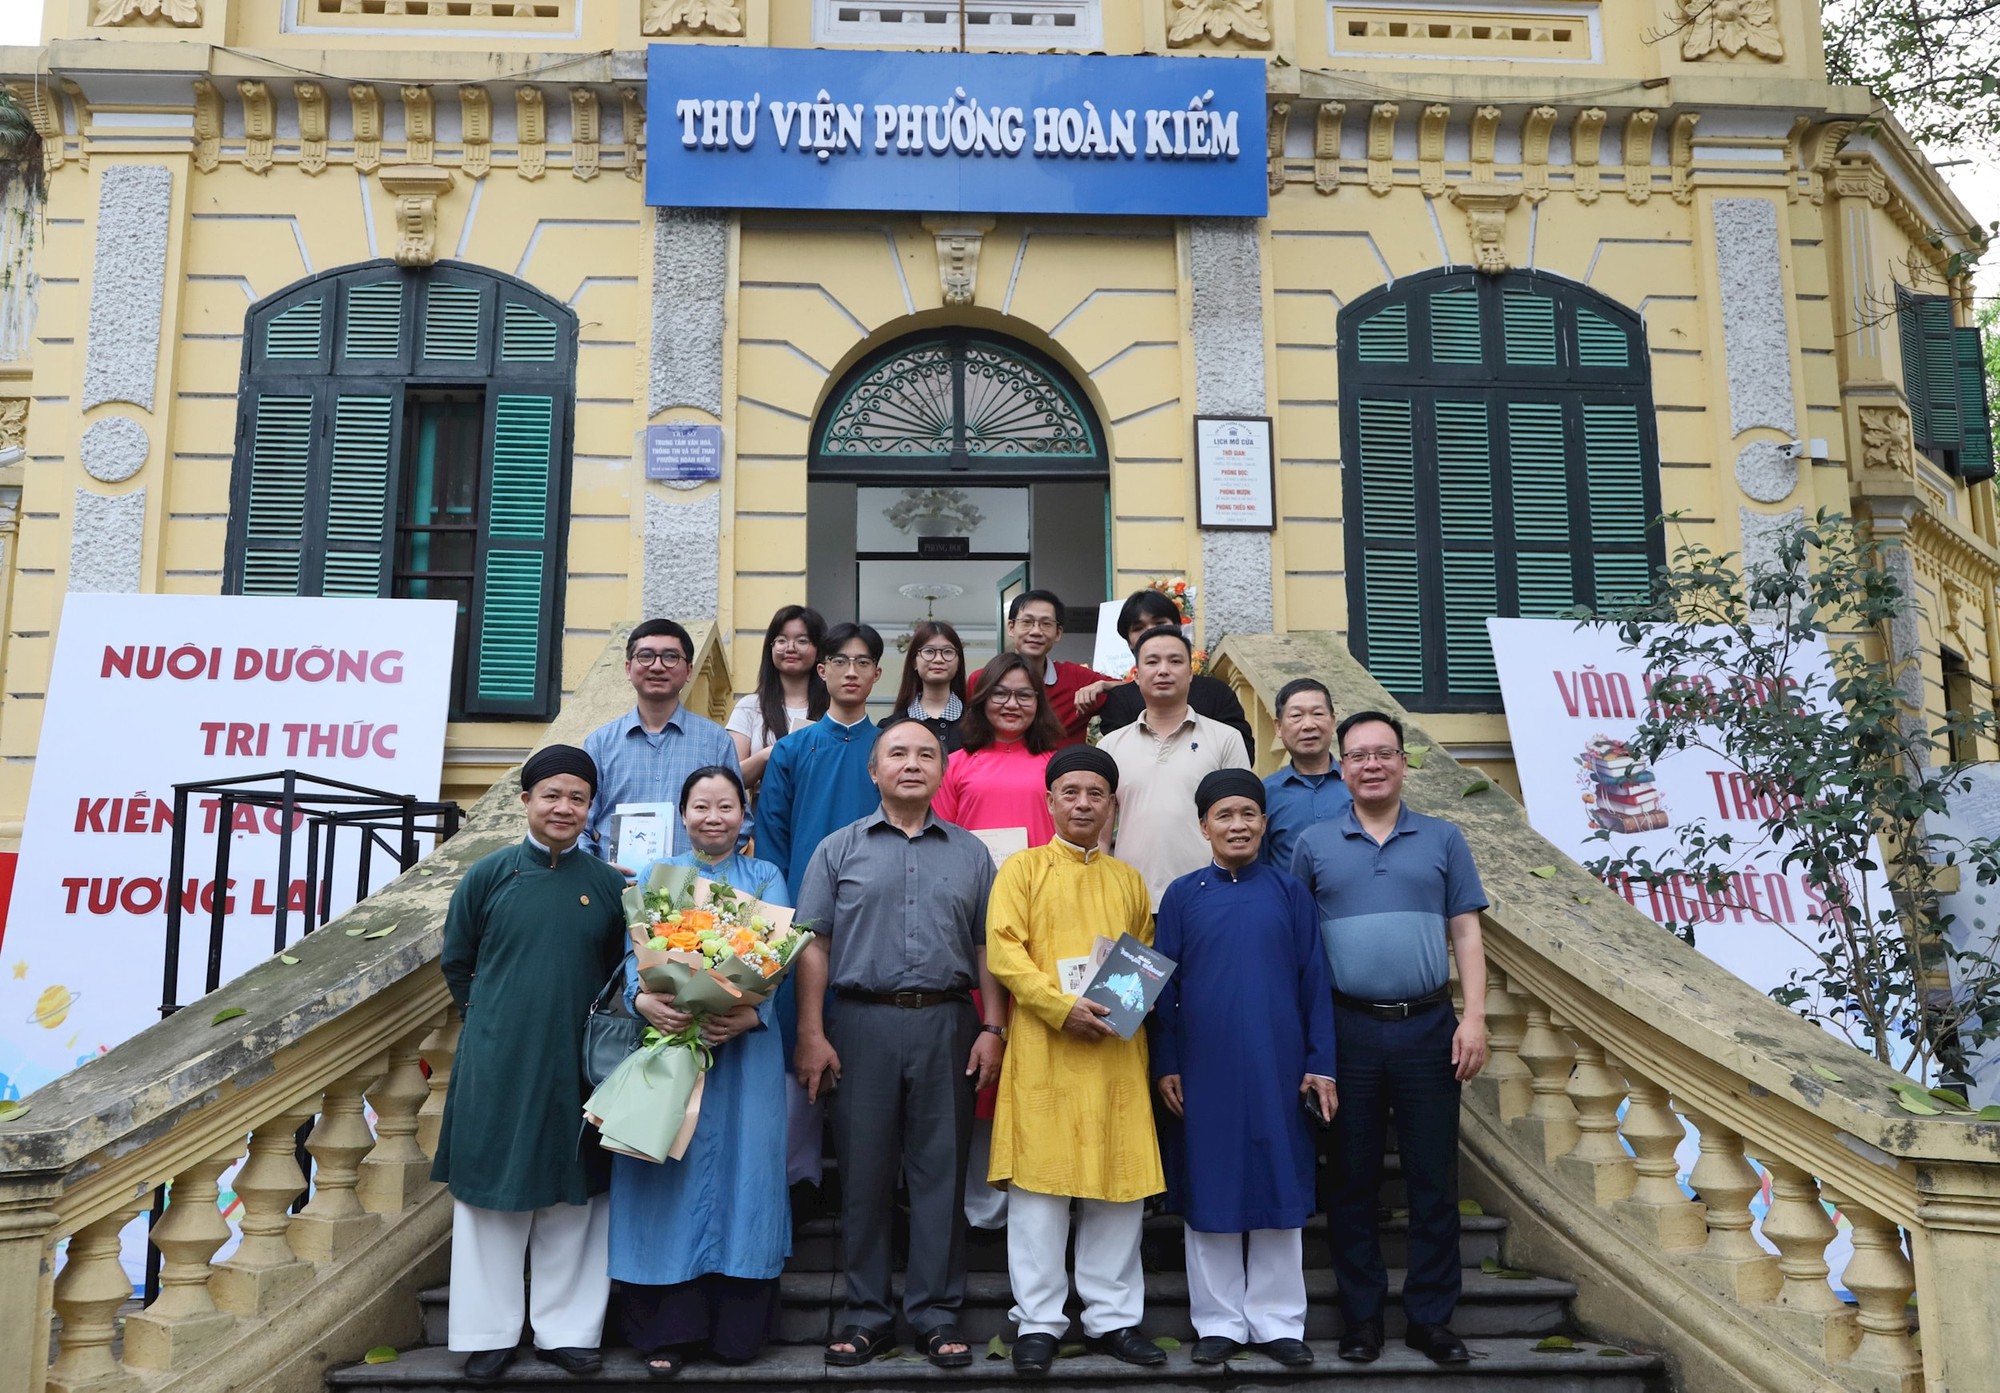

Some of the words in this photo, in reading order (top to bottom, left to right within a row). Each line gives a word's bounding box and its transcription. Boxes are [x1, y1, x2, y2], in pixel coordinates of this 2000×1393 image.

[677, 91, 760, 148] THƯ
[769, 88, 864, 162] VIỆN
[874, 86, 1026, 153] PHƯỜNG
[1033, 100, 1137, 155] HOÀN
[1145, 89, 1240, 156] KIẾM
[1214, 438, 1228, 446] LỊCH
[1241, 438, 1254, 446] CỬA
[100, 642, 222, 680] NUÔI
[233, 645, 405, 684] DƯỠNG
[1553, 664, 1636, 718] VĂN
[200, 722, 270, 757] TRI
[282, 720, 398, 759] THỨC
[199, 799, 304, 839] TẠO
[61, 876, 237, 915] TƯƠNG
[1645, 864, 1796, 924] NGUYÊN
